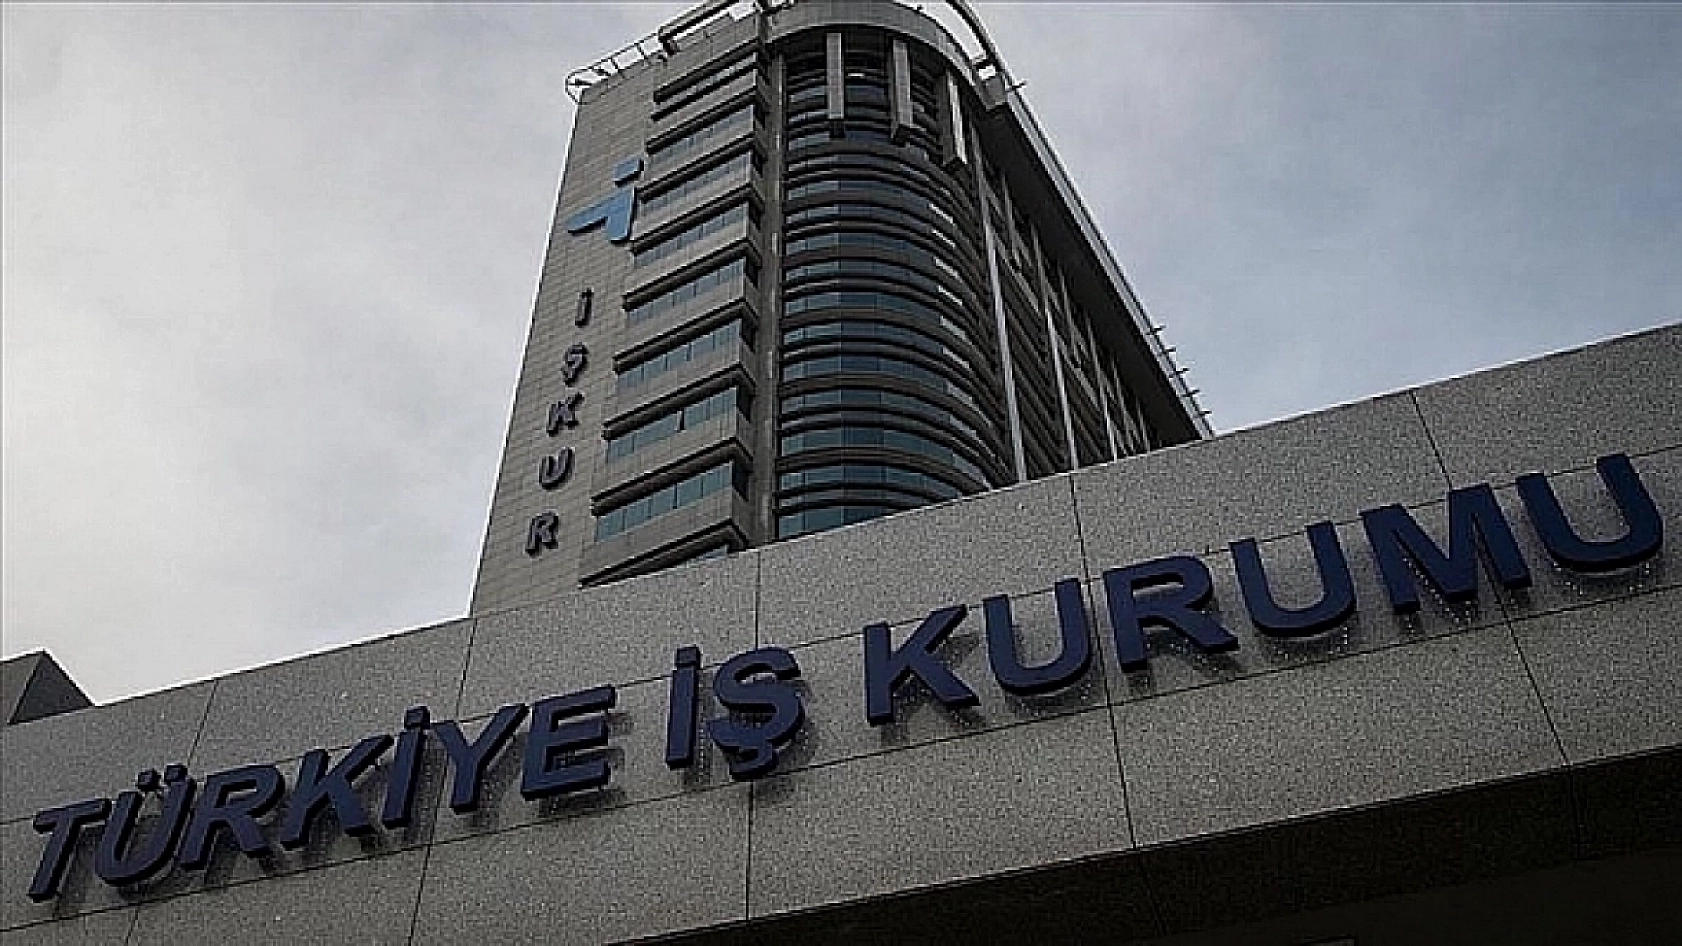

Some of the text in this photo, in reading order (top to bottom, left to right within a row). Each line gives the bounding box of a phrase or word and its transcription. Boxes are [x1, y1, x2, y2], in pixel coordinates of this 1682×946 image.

[27, 453, 1664, 901] TÜRKİYE İŞ KURUMU
